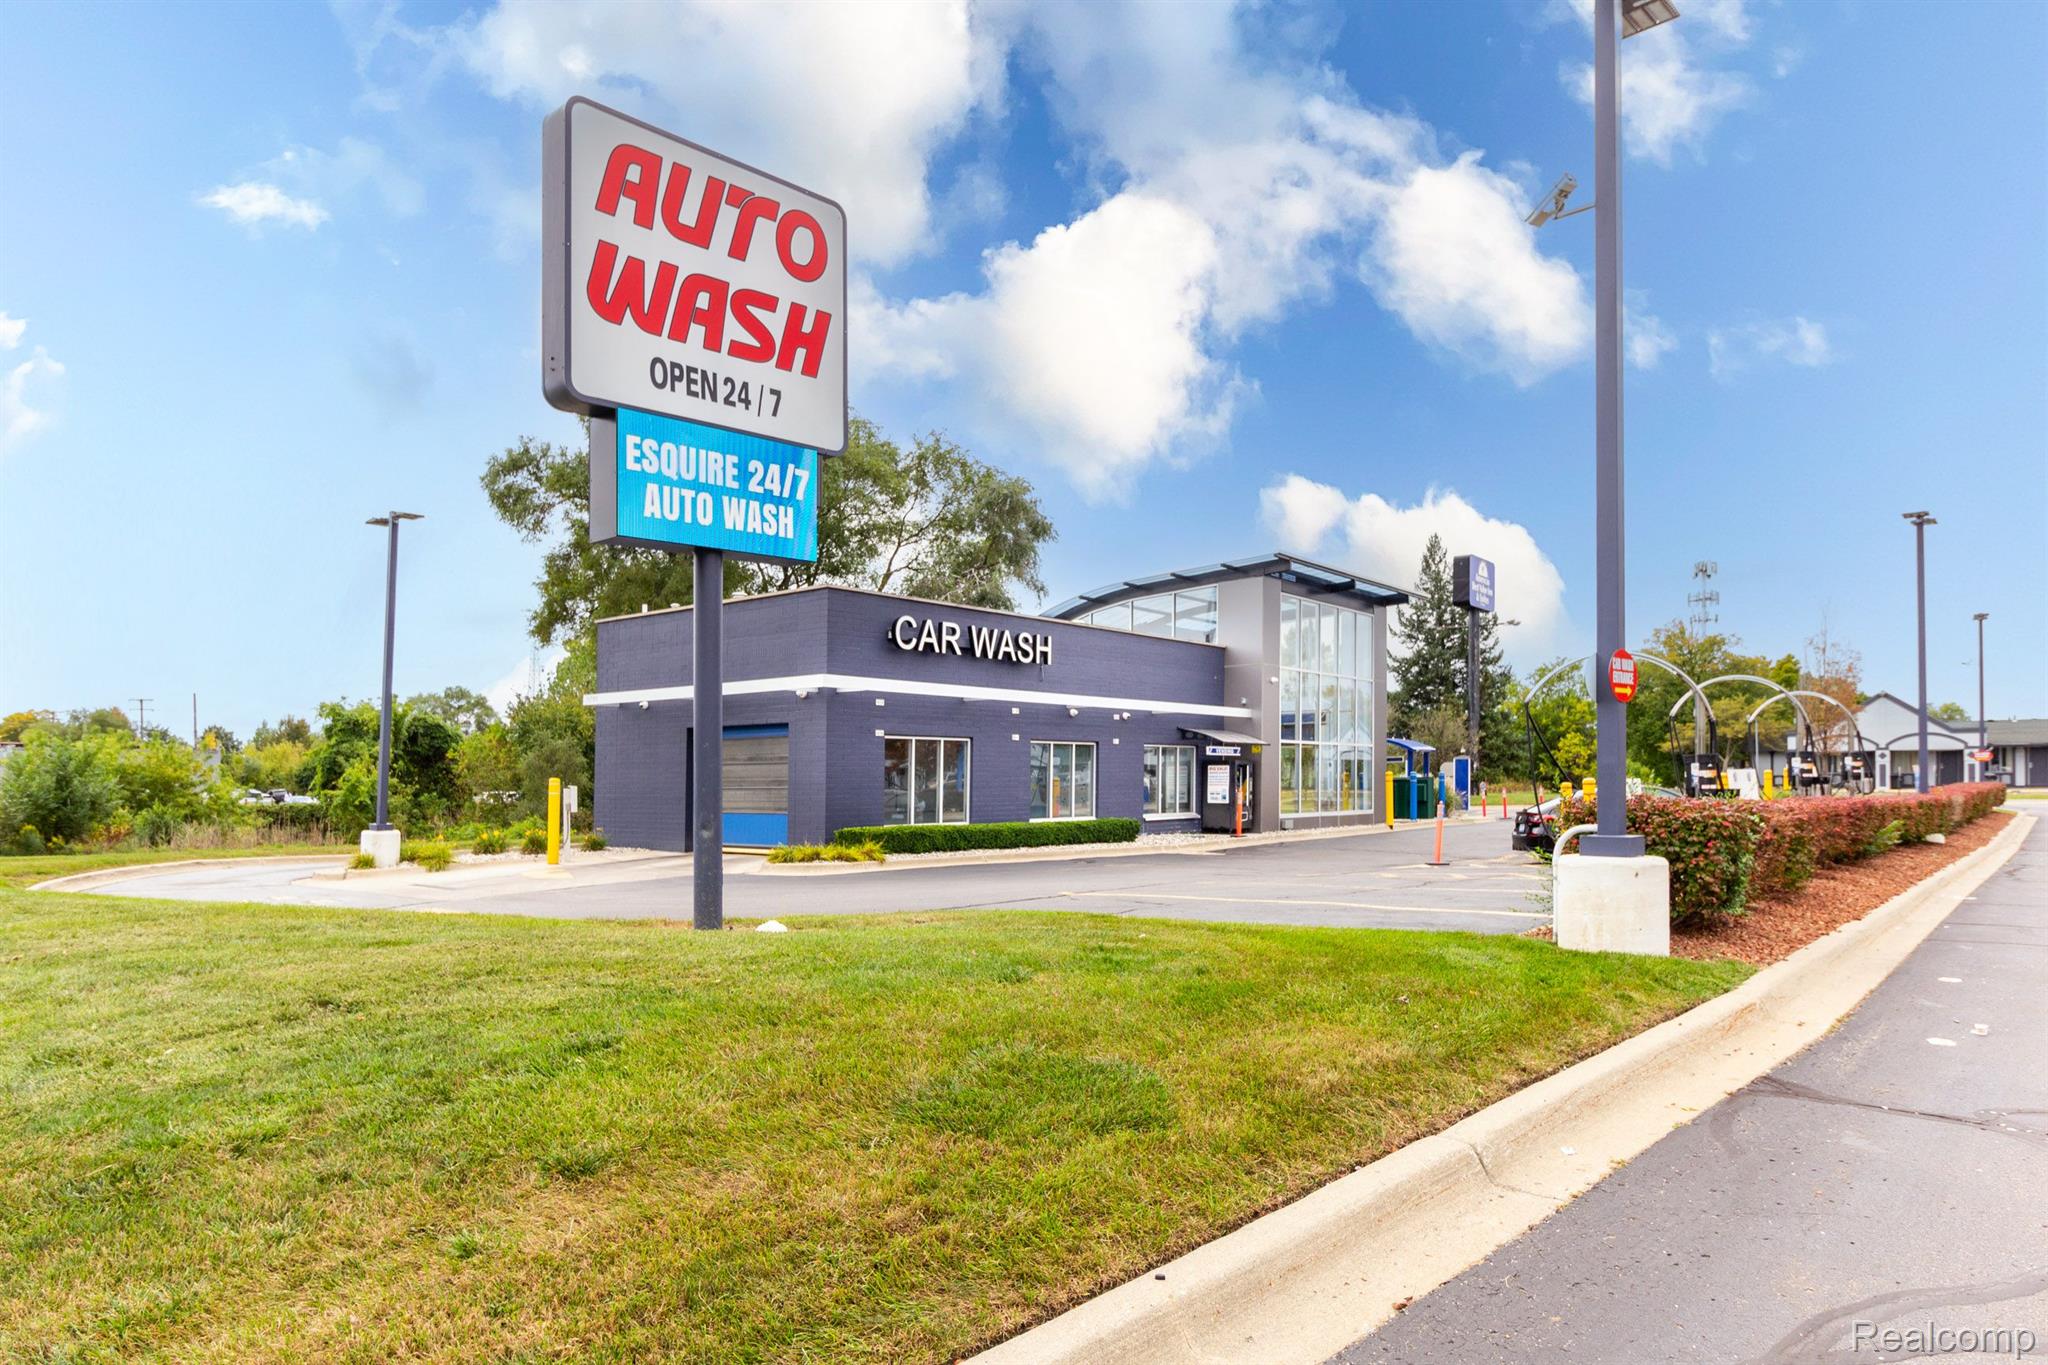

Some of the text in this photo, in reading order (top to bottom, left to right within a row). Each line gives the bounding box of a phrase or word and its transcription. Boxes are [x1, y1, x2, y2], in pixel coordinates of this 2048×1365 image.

[595, 143, 828, 282] AUTO
[587, 239, 832, 379] WASH
[650, 357, 718, 403] OPEN
[626, 434, 809, 500] ESQUIRE 24/7
[643, 483, 794, 539] AUTO WASH
[895, 615, 1052, 665] CAR WASH
